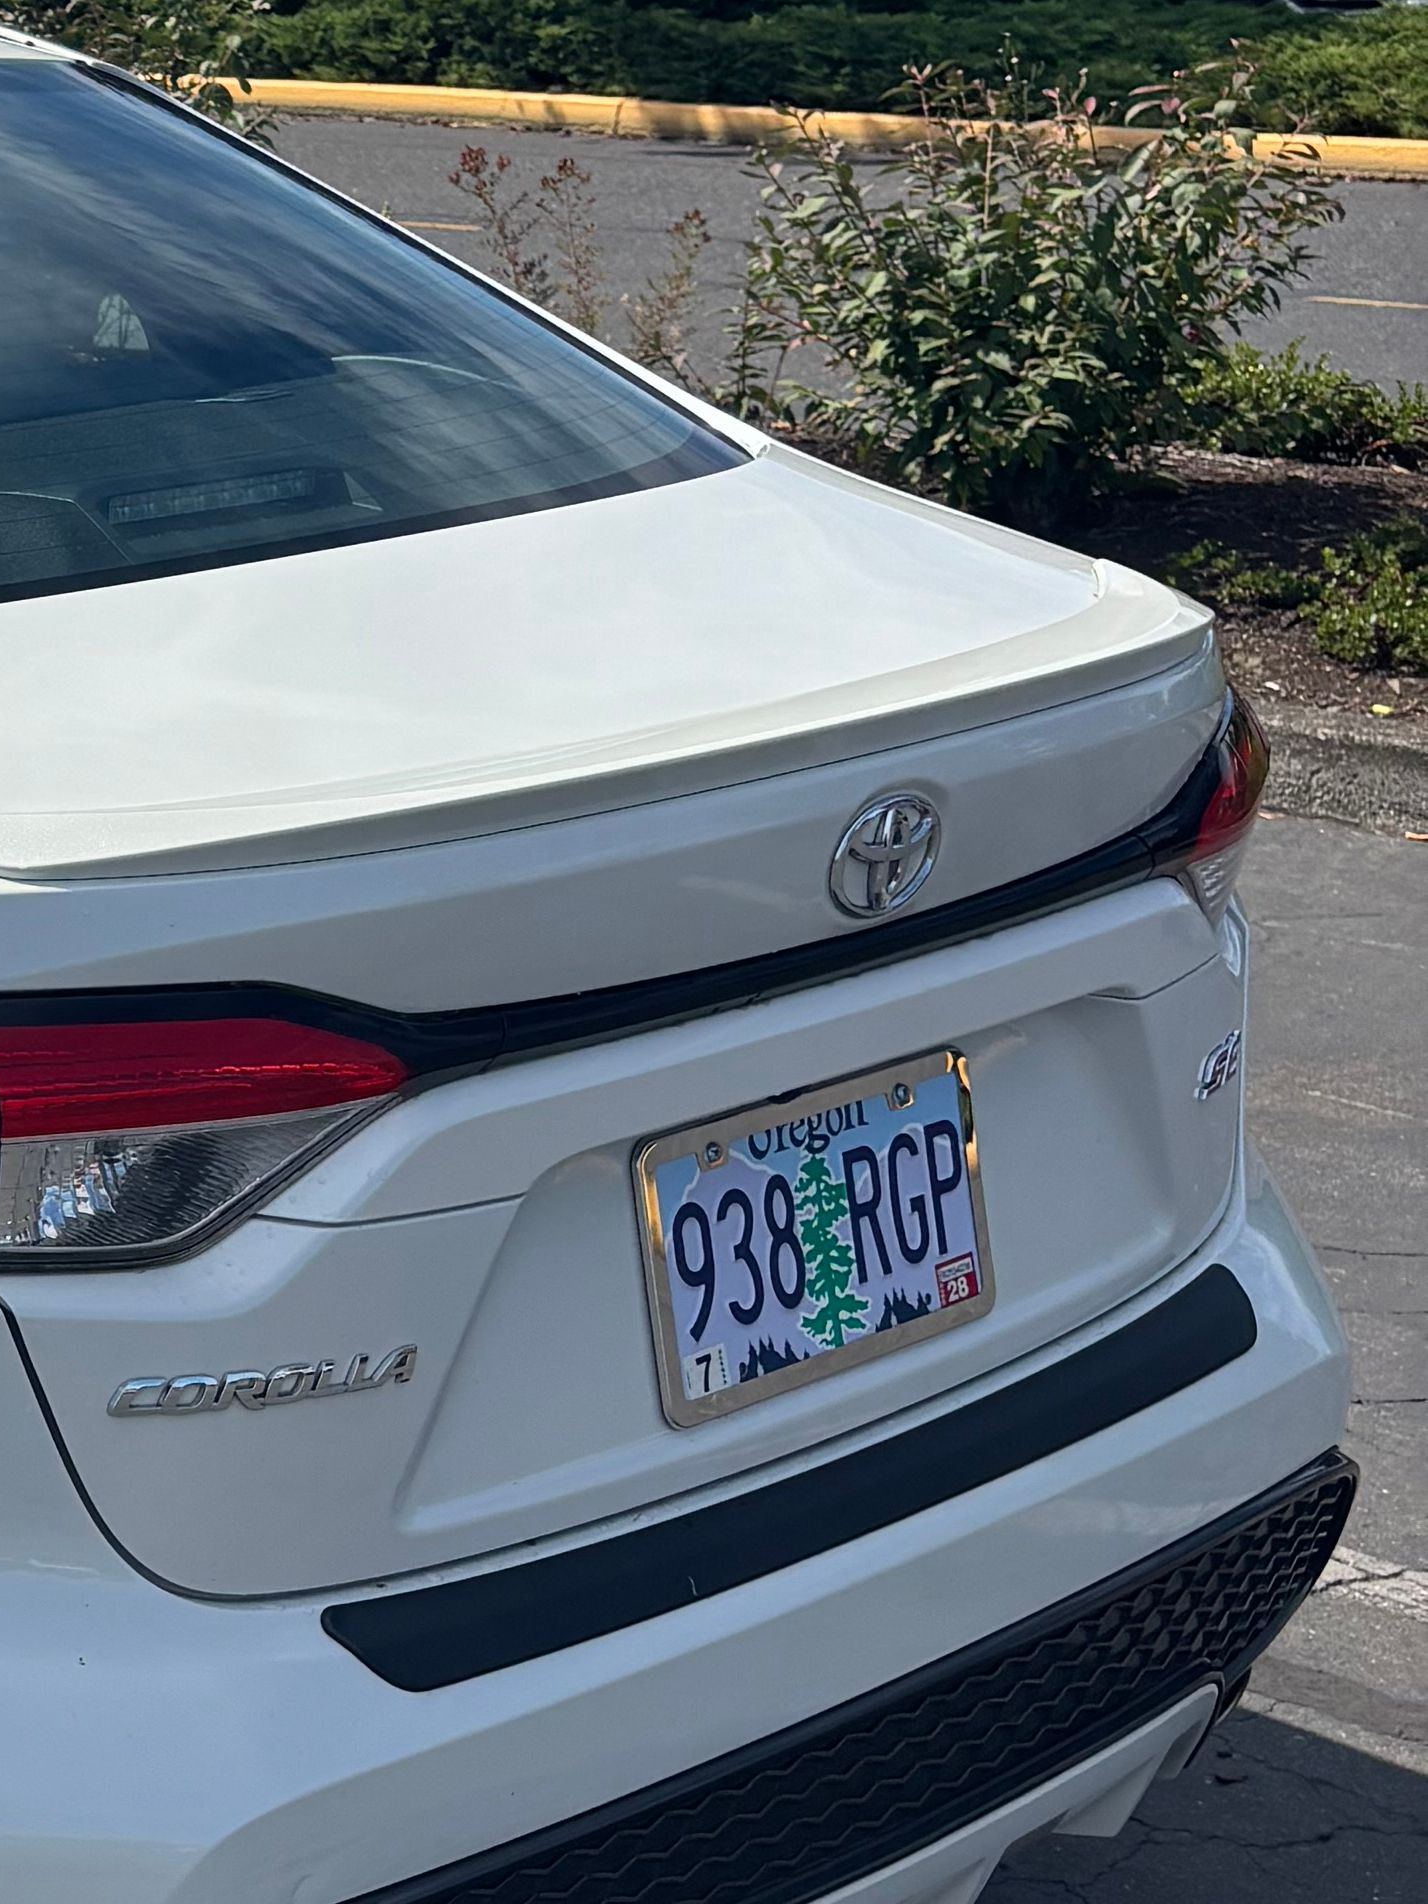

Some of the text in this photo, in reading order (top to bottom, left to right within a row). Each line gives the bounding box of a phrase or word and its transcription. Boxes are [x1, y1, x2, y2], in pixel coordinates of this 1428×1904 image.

[747, 1099, 870, 1161] Oregon
[672, 1119, 962, 1344] 938 RGP
[947, 1276, 969, 1302] 28
[106, 1343, 418, 1418] COROLLA
[695, 1352, 712, 1393] 7
